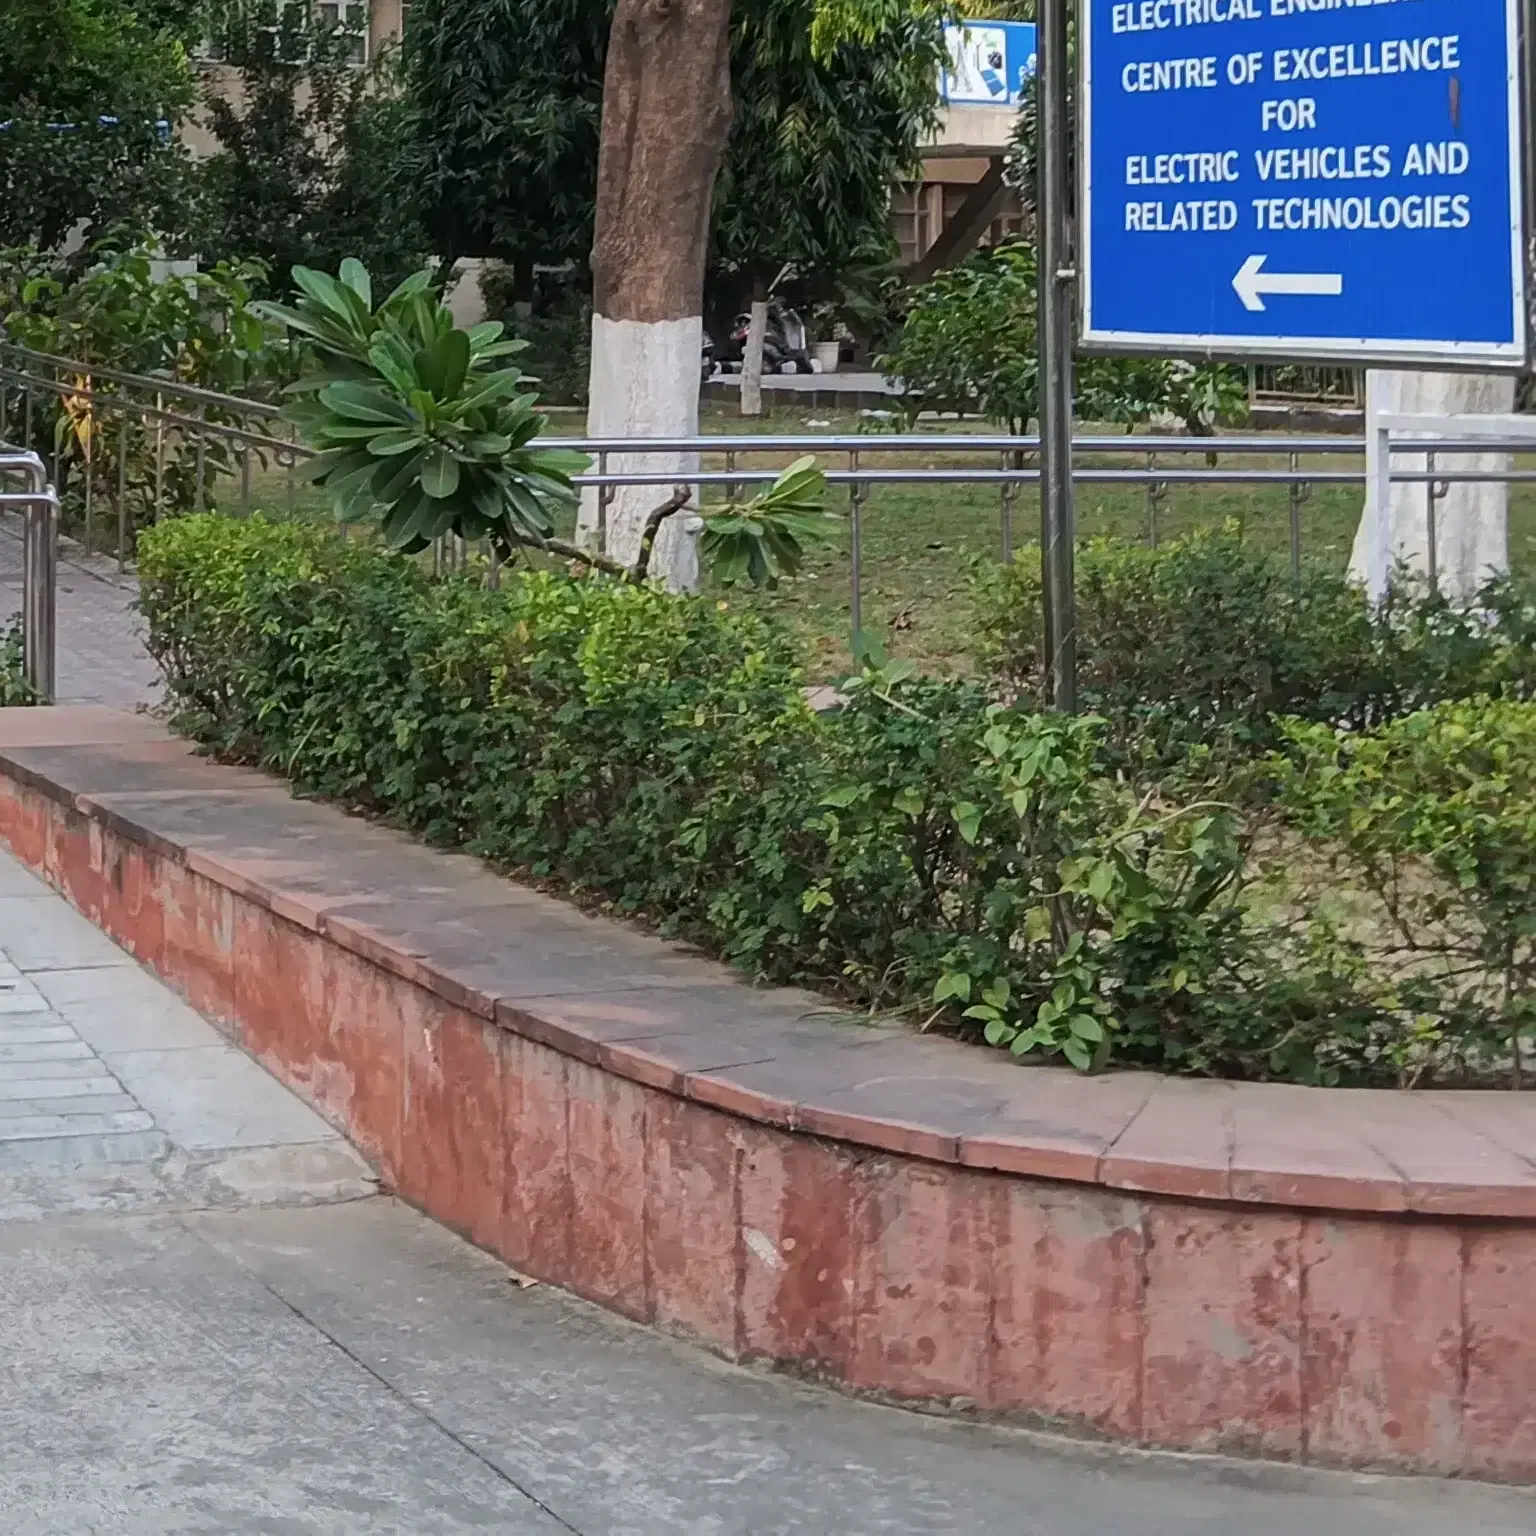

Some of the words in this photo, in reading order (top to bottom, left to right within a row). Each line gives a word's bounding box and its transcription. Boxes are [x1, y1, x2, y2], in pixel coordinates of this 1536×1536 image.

[1122, 56, 1217, 93] CENTRE
[1227, 51, 1263, 86] OF
[1273, 35, 1460, 82] EXCELLENCE
[1261, 97, 1316, 132] FOR
[1125, 150, 1239, 185] ELECTRIC
[1254, 144, 1391, 181] VEHICLES
[1402, 140, 1469, 176] AND
[1124, 200, 1238, 232] RELATED
[1251, 194, 1470, 231] TECHNOLOGIES
